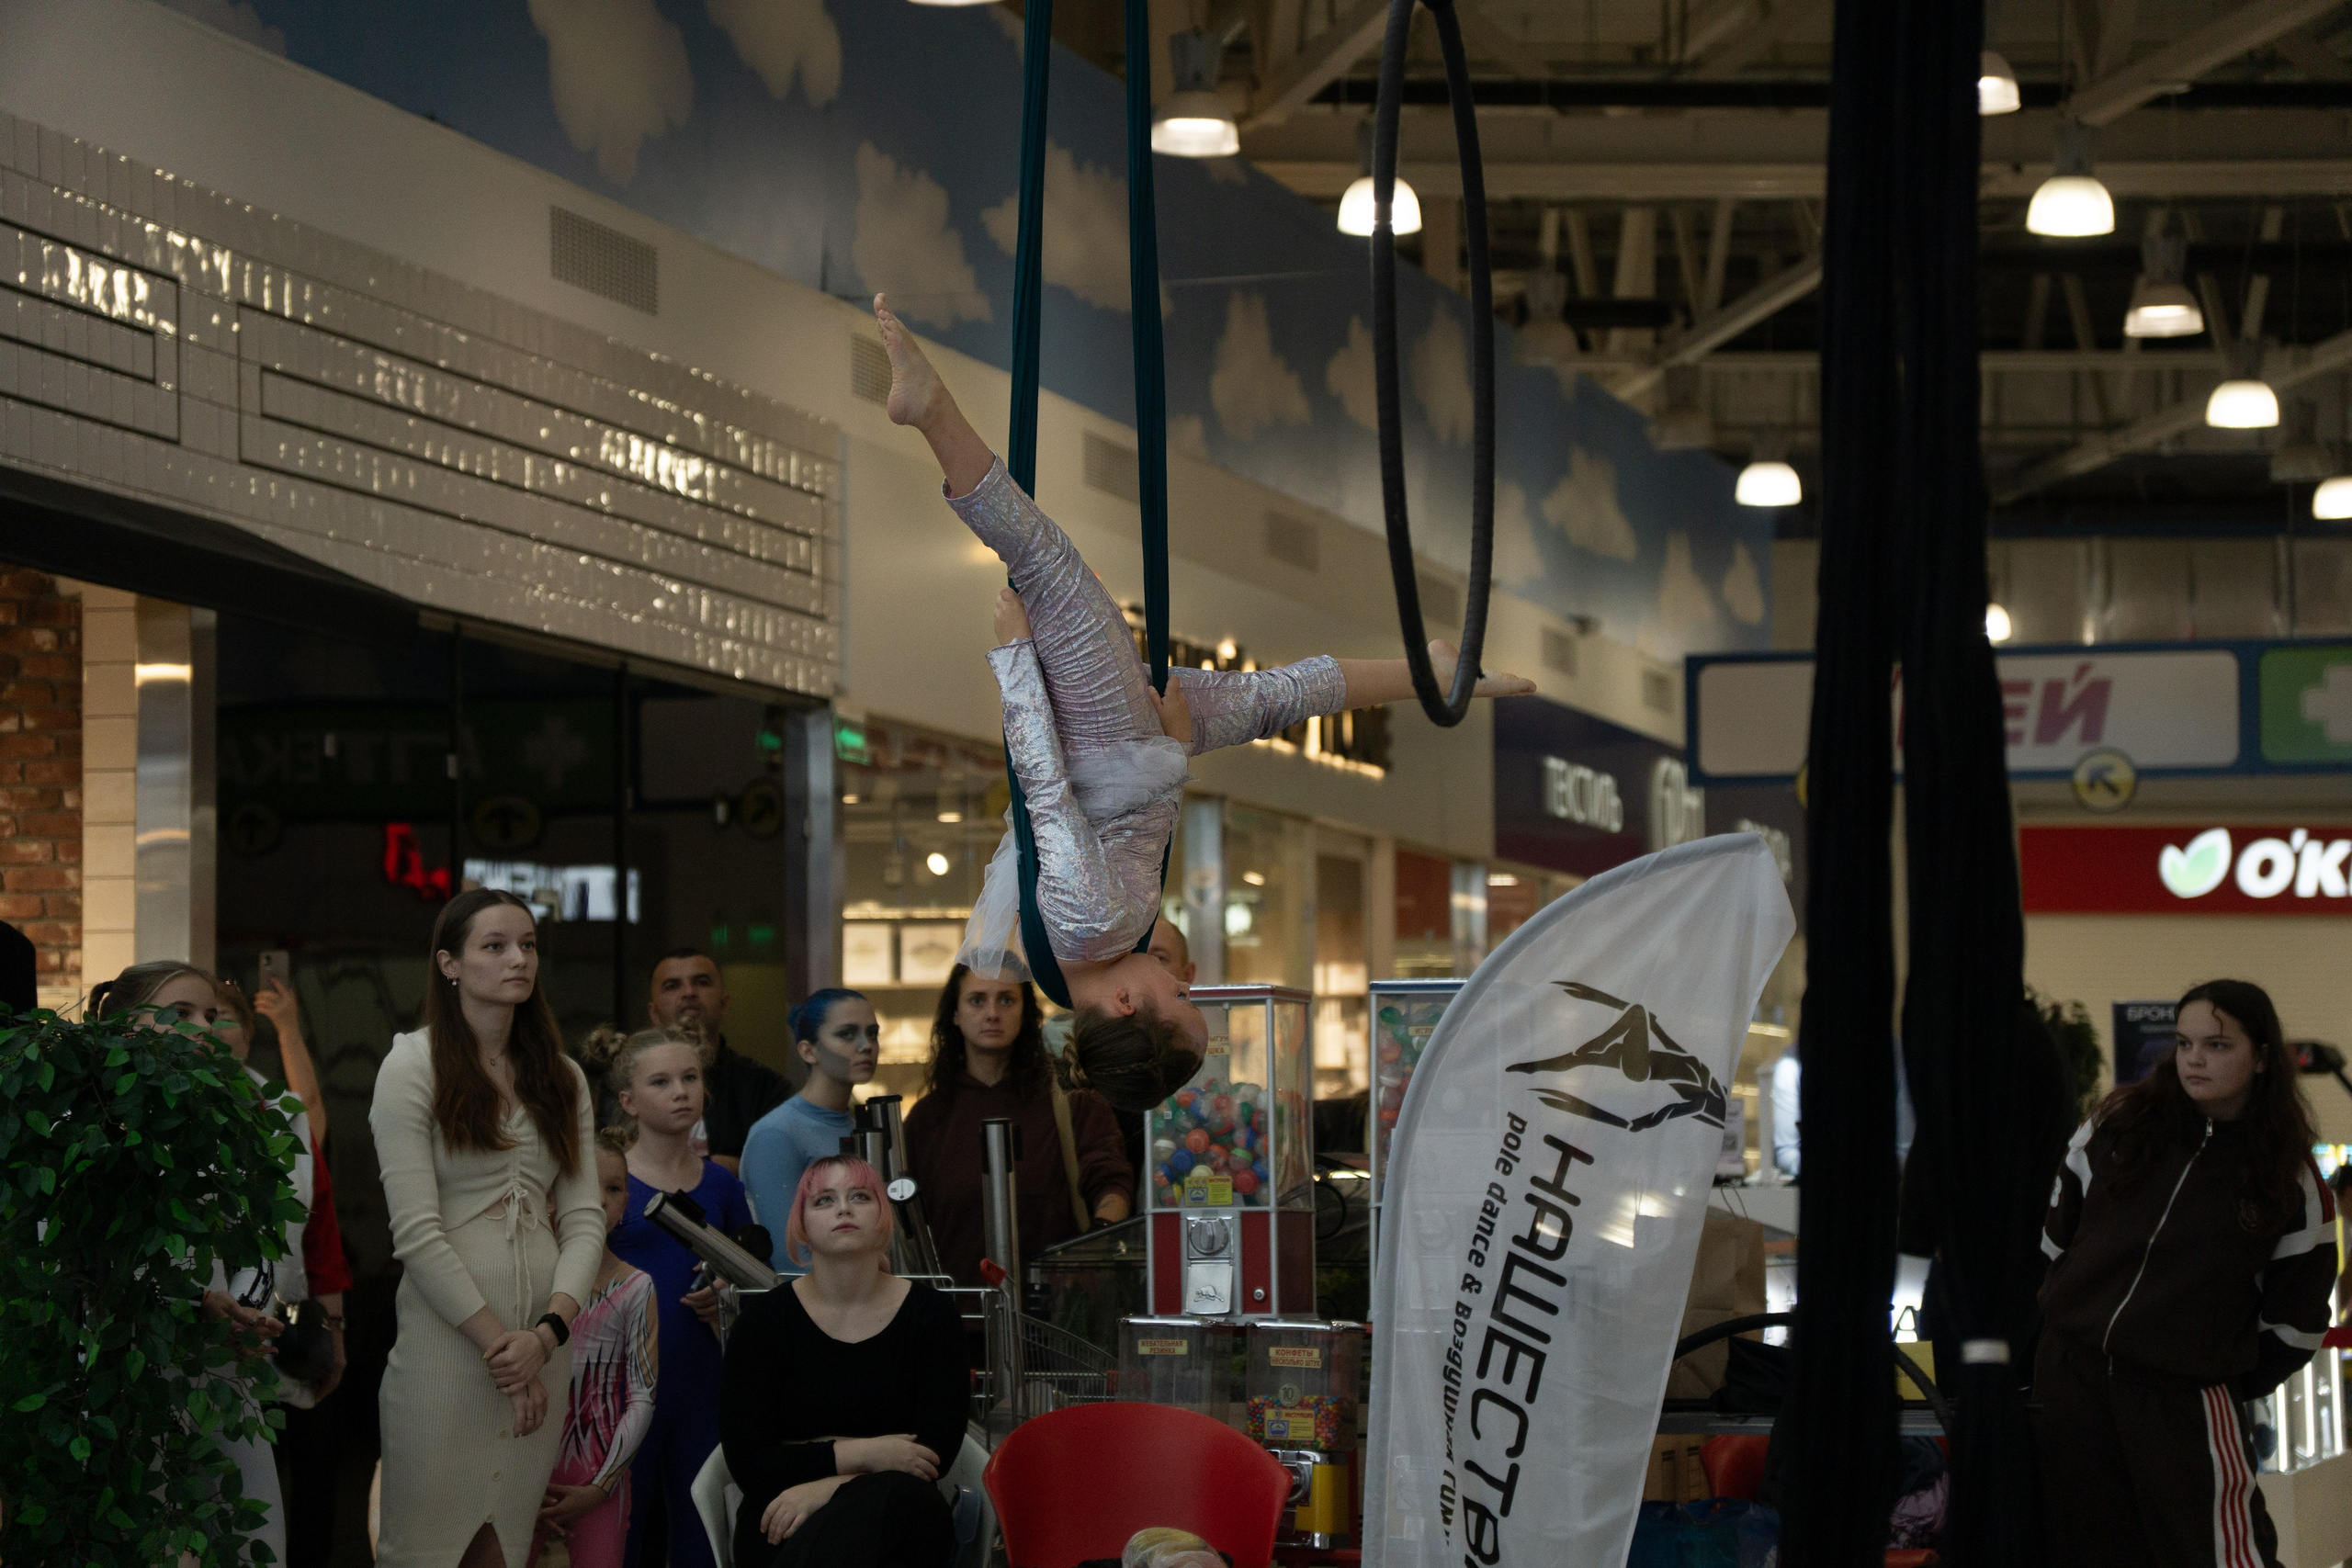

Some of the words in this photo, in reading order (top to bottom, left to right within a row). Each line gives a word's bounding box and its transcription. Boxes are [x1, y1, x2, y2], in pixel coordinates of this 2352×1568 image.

[2235, 827, 2352, 898] О'К
[1495, 1111, 1528, 1177] pole
[1467, 1181, 1508, 1269] dance
[1461, 1272, 1483, 1294] &
[1272, 1358, 1304, 1366] НЕСКОЛЬКО
[1275, 1349, 1314, 1358] КОНФЕТЫ
